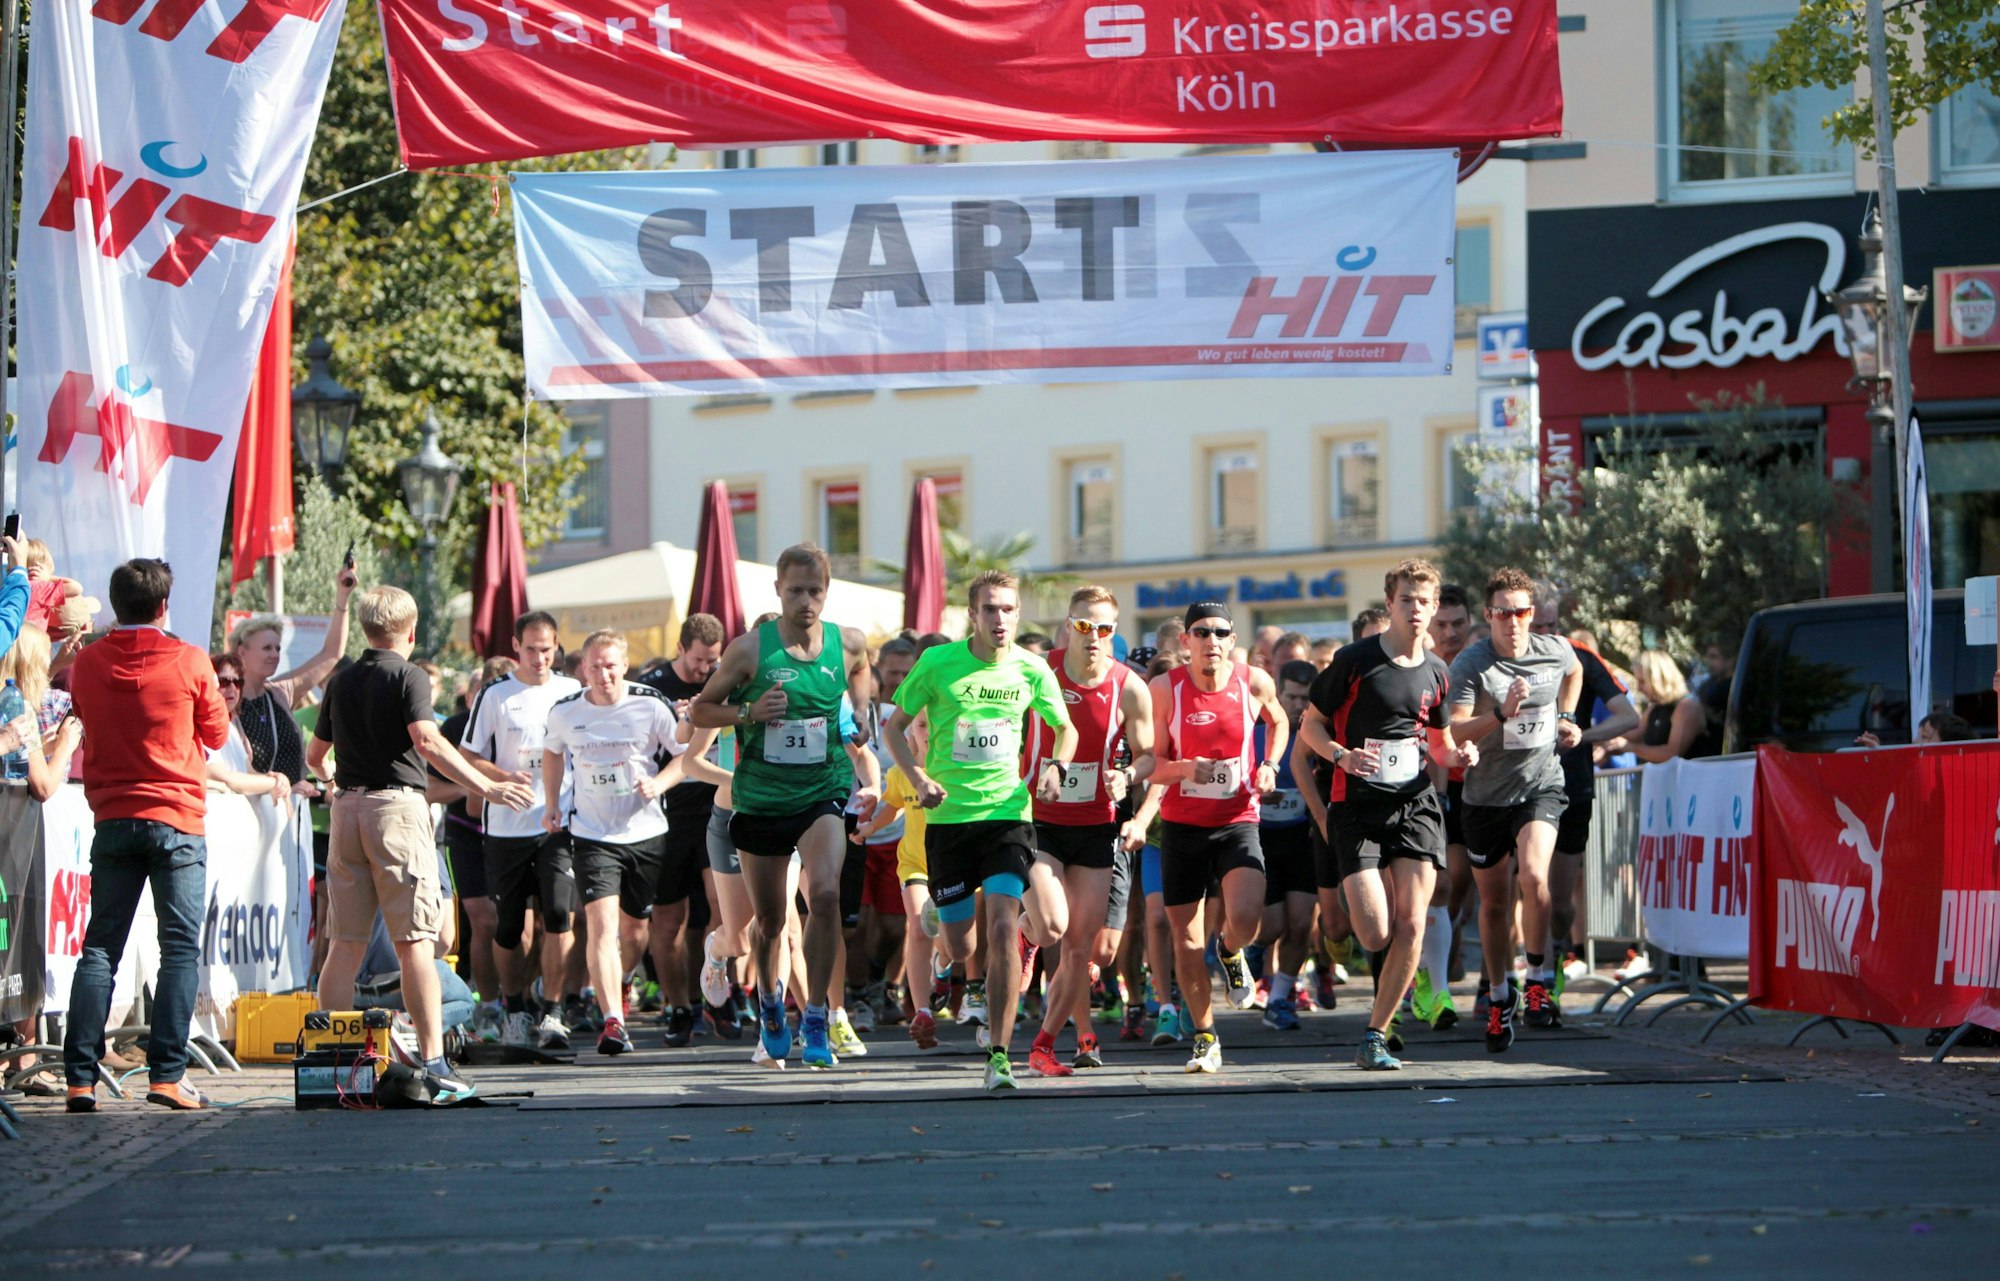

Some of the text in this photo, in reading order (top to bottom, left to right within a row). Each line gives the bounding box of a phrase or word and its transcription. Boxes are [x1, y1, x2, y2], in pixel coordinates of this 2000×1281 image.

[441, 0, 687, 59] Start
[1173, 5, 1514, 57] Kreissparkasse
[1177, 71, 1276, 113] Köln
[39, 136, 276, 287] HIT
[637, 195, 1139, 320] START
[1227, 275, 1436, 339] HIT
[1197, 346, 1385, 364] Wo gut leben wenig kostet!
[1239, 570, 1302, 602] Bank
[1310, 568, 1345, 598] eG
[1524, 667, 1554, 686] nert
[978, 685, 1021, 701] bunert
[809, 720, 825, 729] HIT
[1517, 721, 1545, 736] 377
[785, 735, 807, 749] 31
[967, 734, 999, 749] 100
[1388, 755, 1398, 767] 9
[591, 773, 617, 785] 154
[943, 881, 965, 896] bunert
[202, 879, 280, 980] henag
[1775, 878, 1865, 976] PUMA
[1934, 889, 2000, 988] PUM
